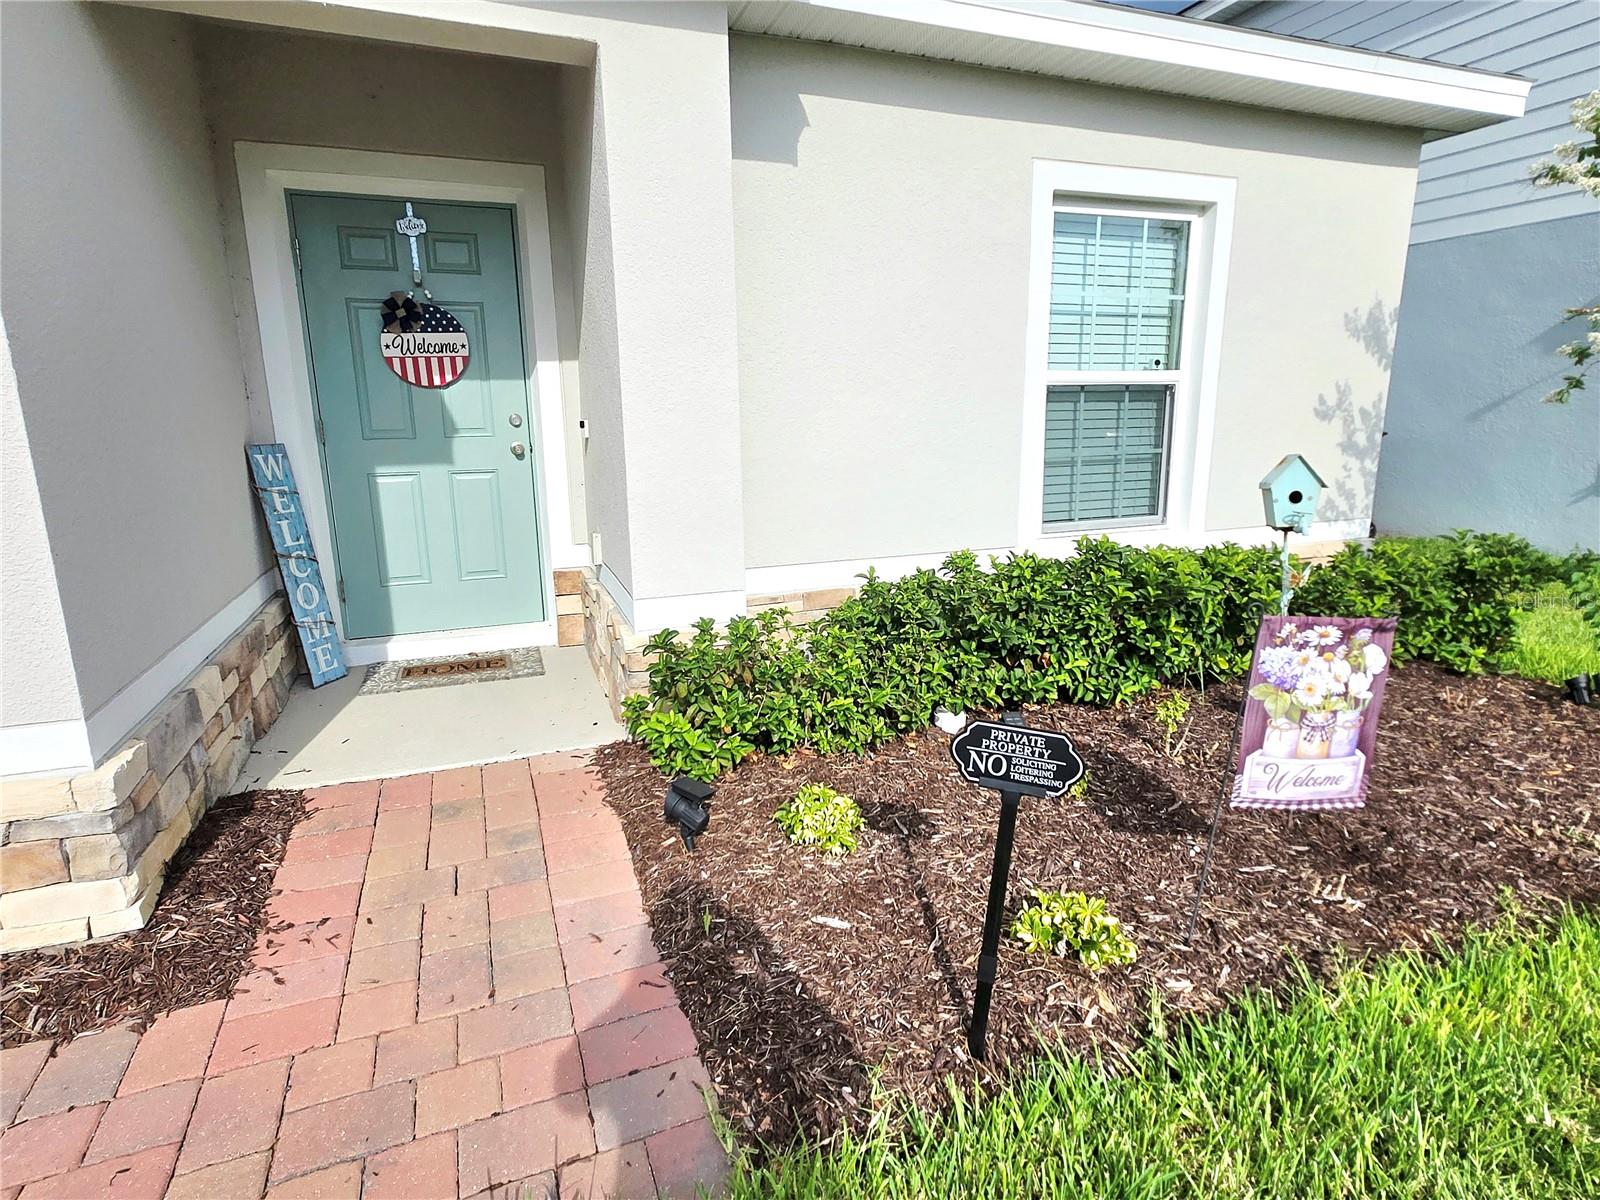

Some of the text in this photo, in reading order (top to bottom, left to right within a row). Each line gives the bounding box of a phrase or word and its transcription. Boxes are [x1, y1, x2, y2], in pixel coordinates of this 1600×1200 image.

[391, 334, 460, 356] Welcome
[253, 453, 339, 674] WELCOME
[404, 657, 507, 677] HOME
[981, 738, 1052, 760] PROPERTY
[990, 729, 1046, 749] PRIVATE
[966, 750, 1008, 777] NO
[1010, 764, 1054, 779] LOITERING
[1011, 756, 1057, 772] SOLICITING
[1009, 772, 1063, 789] TRESPASSING
[1263, 762, 1344, 794] Welcome
